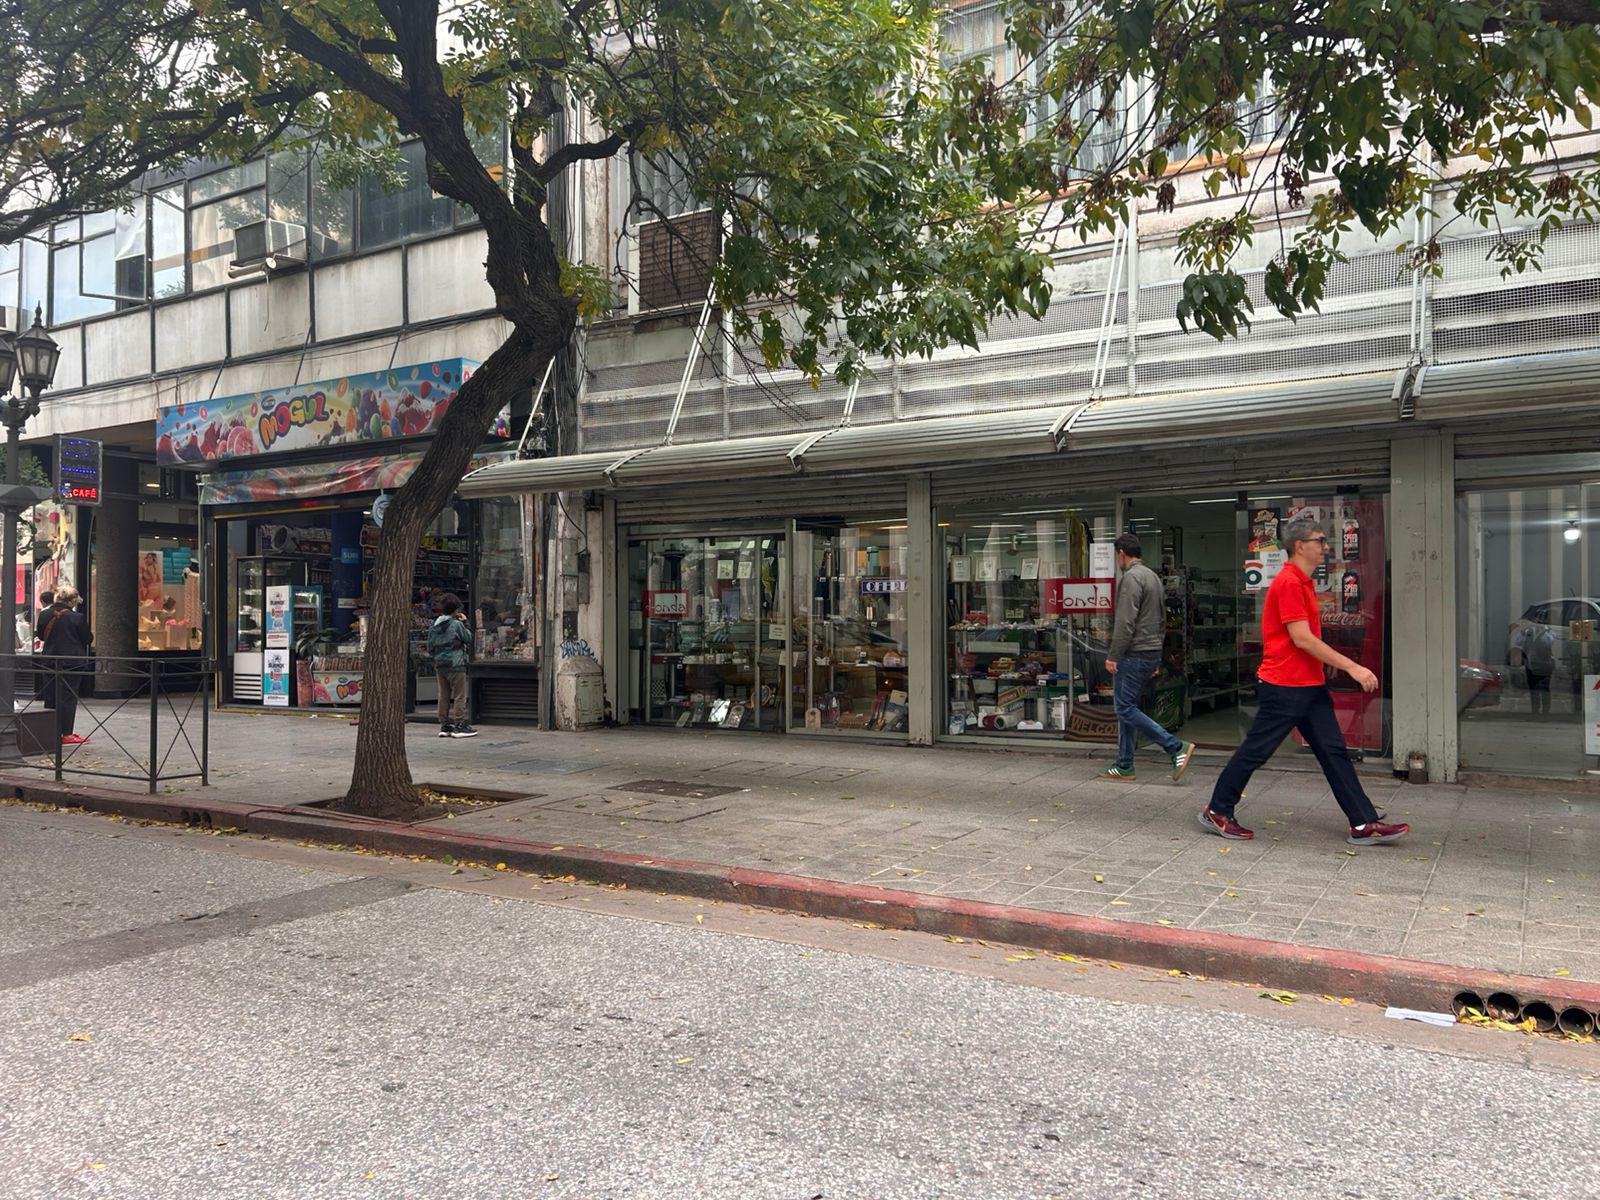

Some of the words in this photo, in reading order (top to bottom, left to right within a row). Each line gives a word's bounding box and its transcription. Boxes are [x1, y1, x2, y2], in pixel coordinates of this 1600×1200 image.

[259, 391, 330, 450] MOGUL
[72, 488, 97, 498] CAFÉ
[1048, 584, 1112, 607] d-onda
[1071, 715, 1118, 734] WELCO
